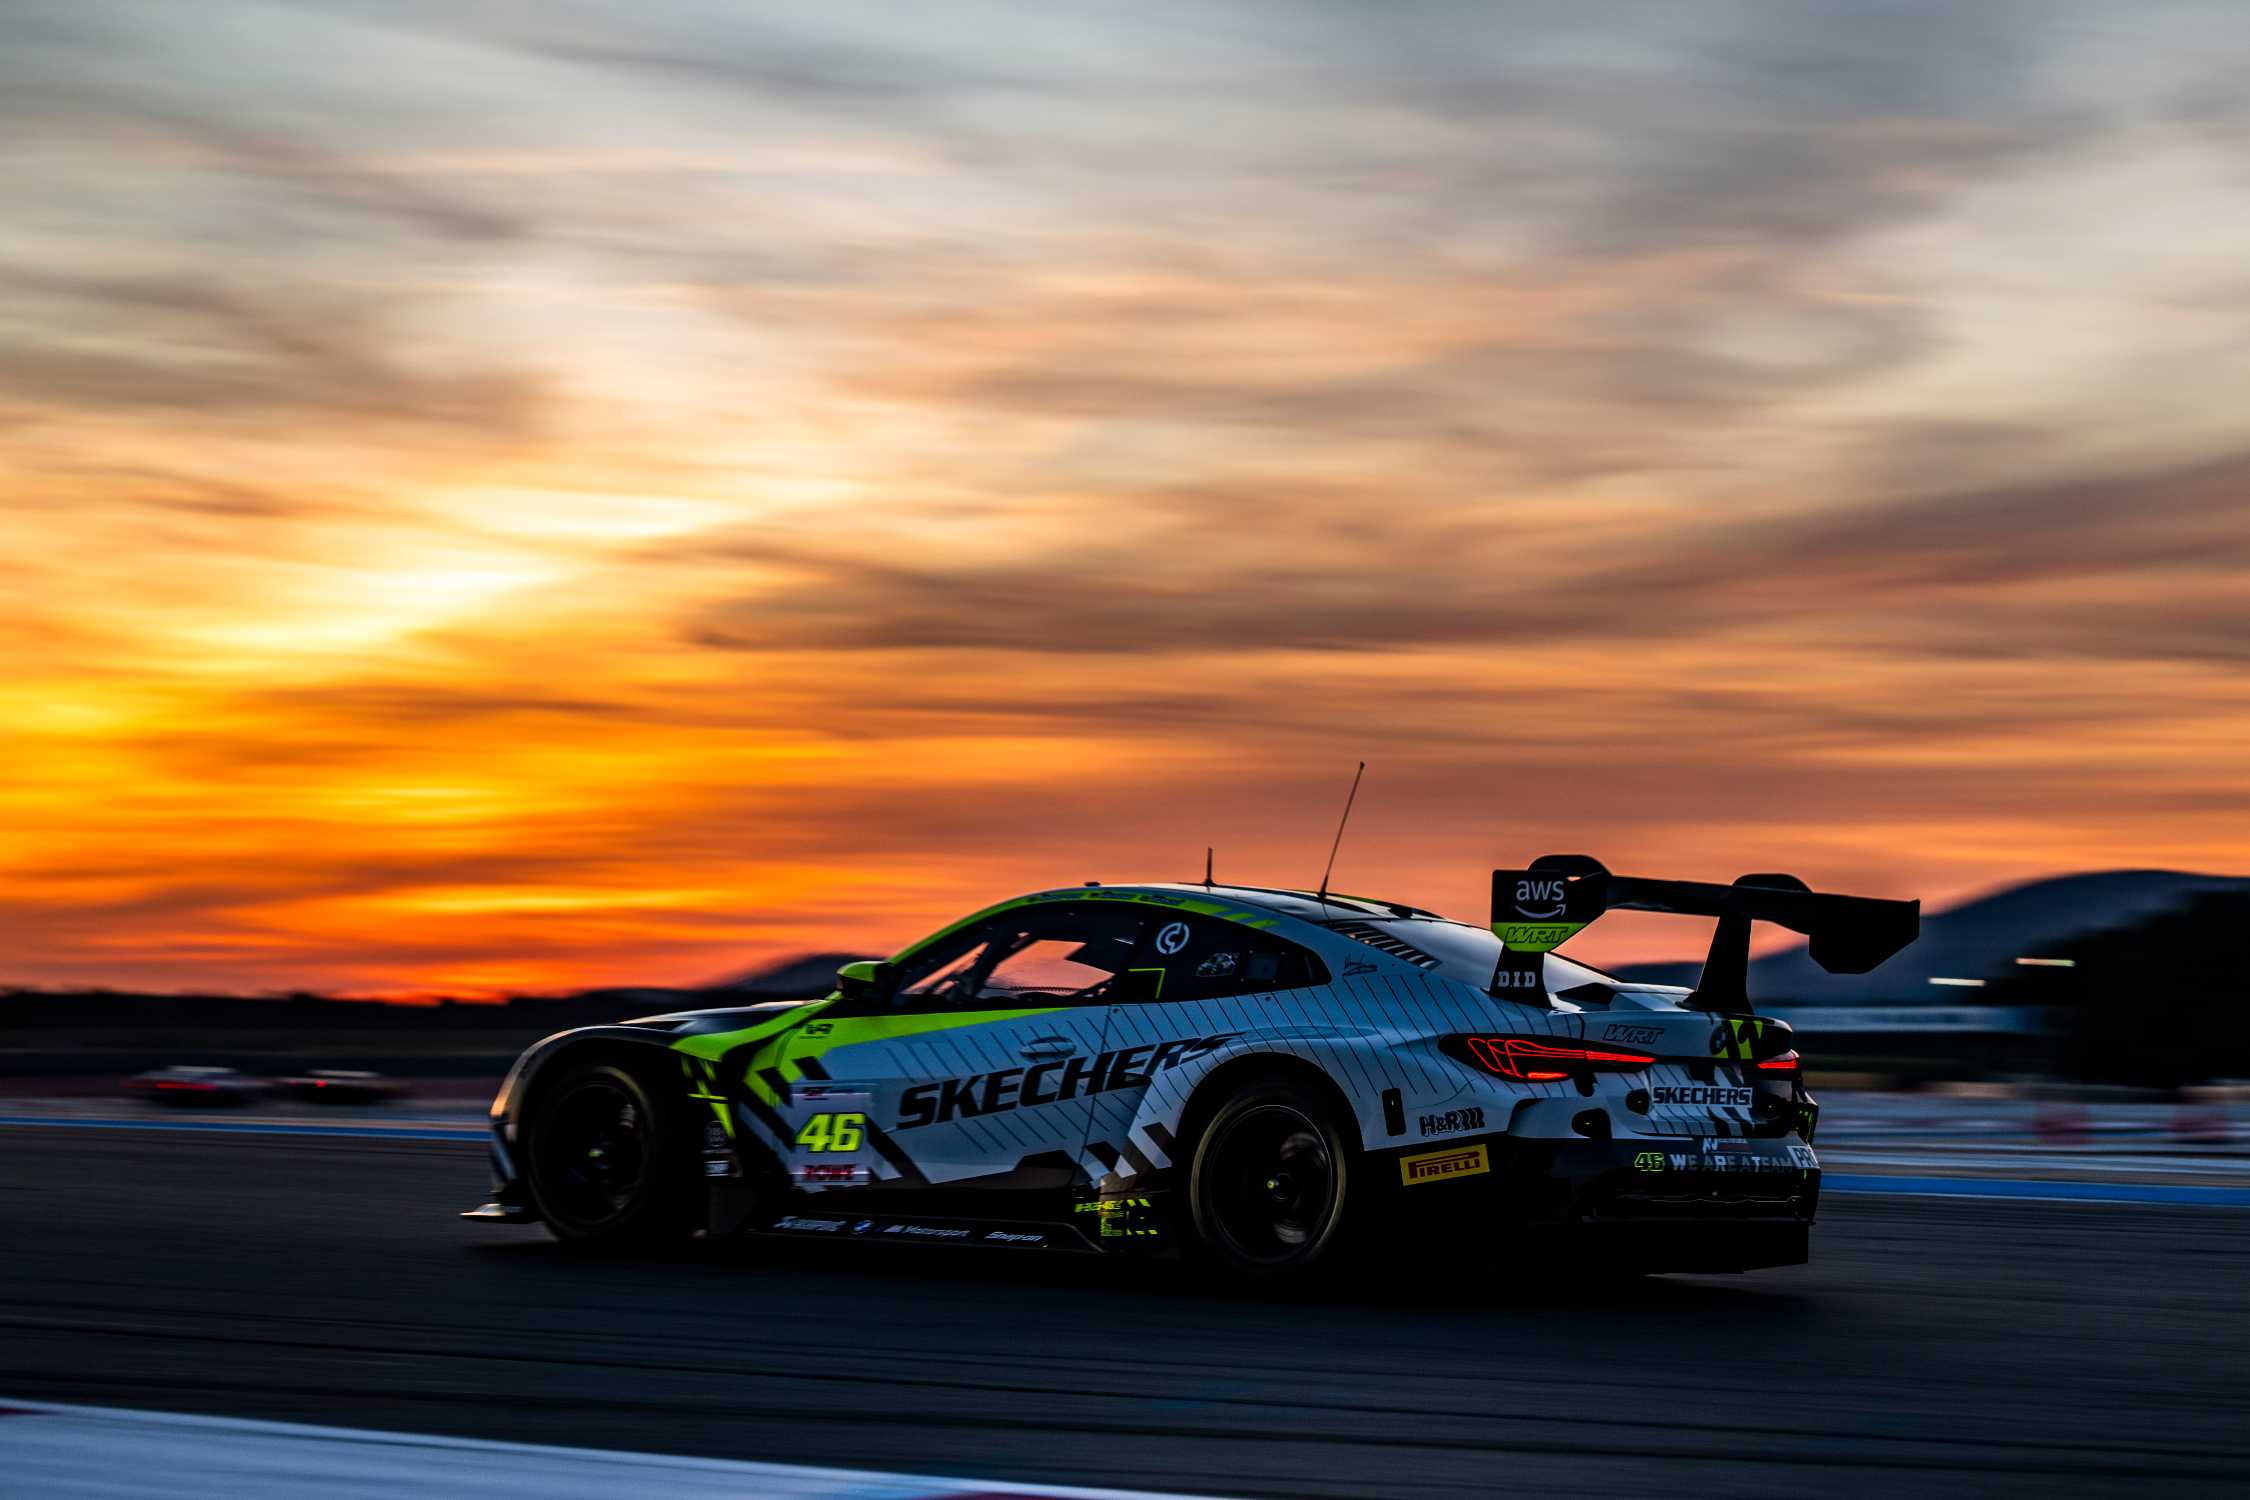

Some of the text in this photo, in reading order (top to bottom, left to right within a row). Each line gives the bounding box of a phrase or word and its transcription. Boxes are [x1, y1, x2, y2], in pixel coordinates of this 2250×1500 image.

[1516, 880, 1565, 901] aws
[1504, 927, 1568, 943] WRT
[1603, 1024, 1665, 1044] WRT
[896, 1031, 1248, 1130] SKECHERS
[1653, 1086, 1752, 1105] SKECHERS
[796, 1112, 866, 1153] 46
[1408, 1151, 1481, 1179] PIRELLI
[1634, 1152, 1665, 1172] 46
[1669, 1153, 1699, 1171] WE
[1703, 1154, 1736, 1172] ARE
[1752, 1156, 1793, 1173] TEAM
